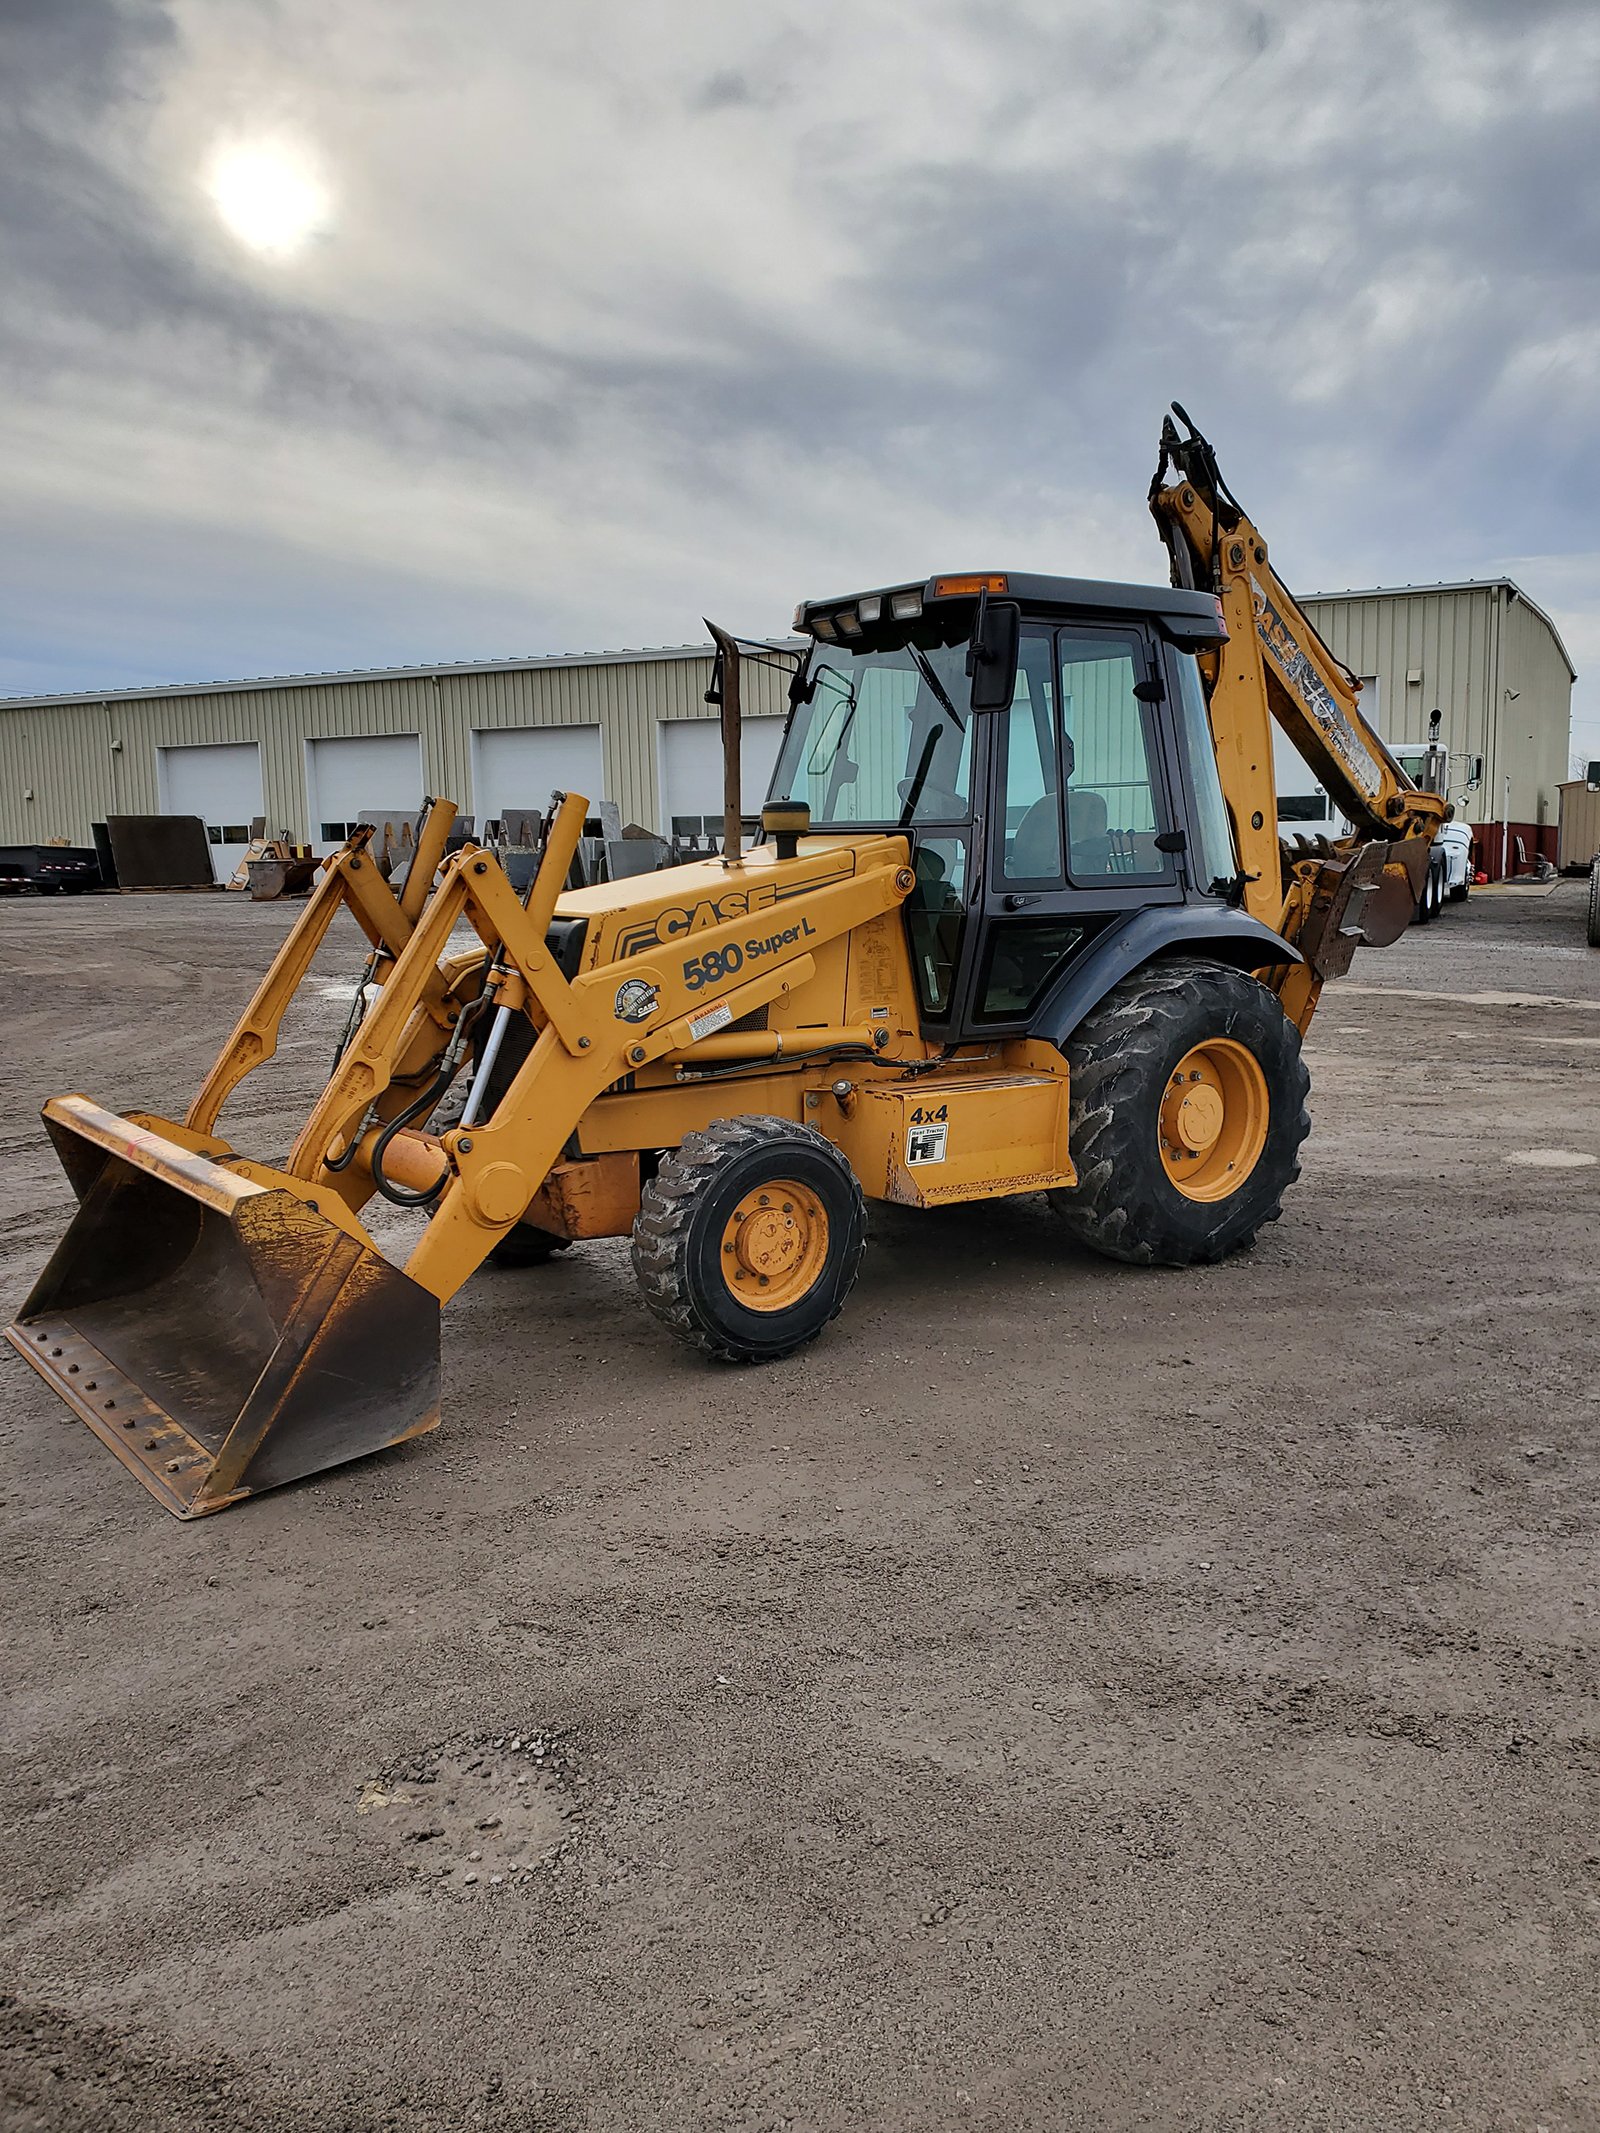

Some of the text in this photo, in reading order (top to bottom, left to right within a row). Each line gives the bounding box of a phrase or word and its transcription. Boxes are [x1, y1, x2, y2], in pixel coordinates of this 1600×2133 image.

[655, 883, 777, 944] CASE
[683, 917, 816, 991] 580 Super L
[910, 1104, 949, 1125] 4x4
